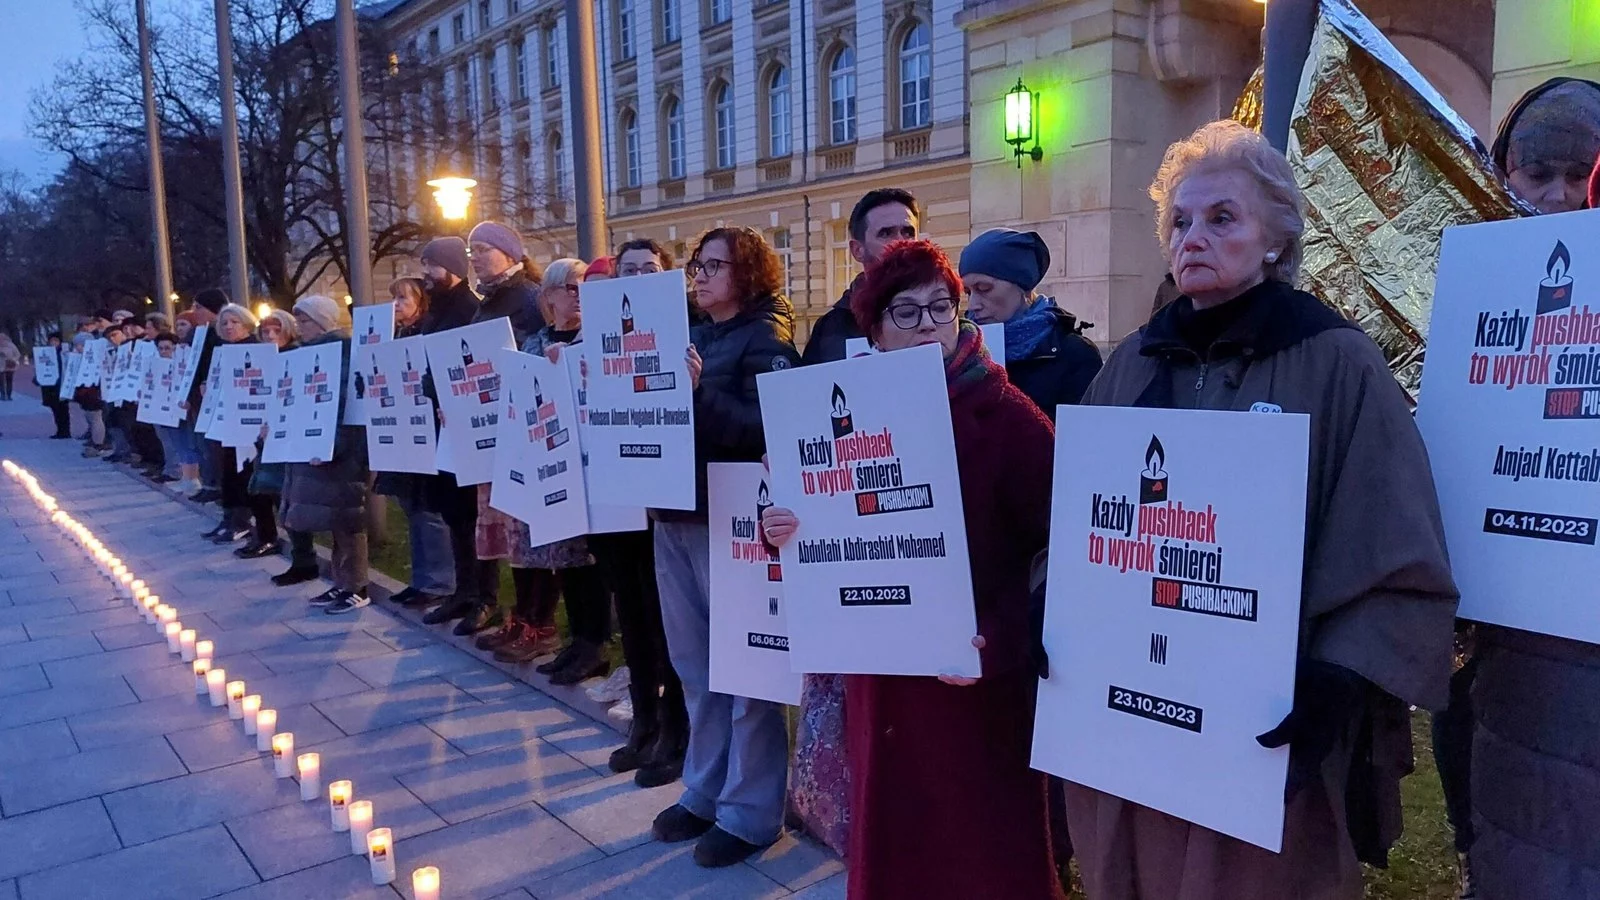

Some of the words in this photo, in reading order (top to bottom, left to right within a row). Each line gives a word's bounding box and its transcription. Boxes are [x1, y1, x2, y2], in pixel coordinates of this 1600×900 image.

[1474, 309, 1530, 352] Każdy
[1469, 352, 1489, 385] to
[1492, 346, 1553, 390] wyrok
[1548, 391, 1580, 416] STOP
[1581, 390, 1600, 416] PU
[621, 446, 659, 455] 20.06.2023
[798, 435, 833, 468] Każdy
[834, 427, 894, 468] pushback
[1493, 445, 1544, 482] Amjad
[801, 470, 815, 495] to
[817, 462, 856, 497] wyrok
[856, 457, 903, 490] śmierci
[858, 493, 878, 514] STOP
[877, 486, 930, 512] PUSHBACKOM!
[731, 516, 756, 541] Każdy
[1091, 493, 1135, 537] Każdy
[1137, 500, 1217, 544] pushback
[1492, 512, 1589, 537] 04.11.2023
[732, 540, 741, 560] to
[798, 538, 842, 564] Abdullahi
[843, 534, 896, 562] Abdirashid
[896, 532, 946, 558] Mohamed
[1088, 532, 1104, 564] to
[1108, 535, 1156, 574] wyrok
[1158, 539, 1222, 584] śmierci
[768, 597, 778, 616] NN
[844, 588, 906, 601] 22.10.2023
[1155, 580, 1180, 606] STOP
[1181, 584, 1253, 618] PUSHBACKOM!
[1150, 632, 1168, 665] NN
[1113, 690, 1196, 724] 23.10.2023
